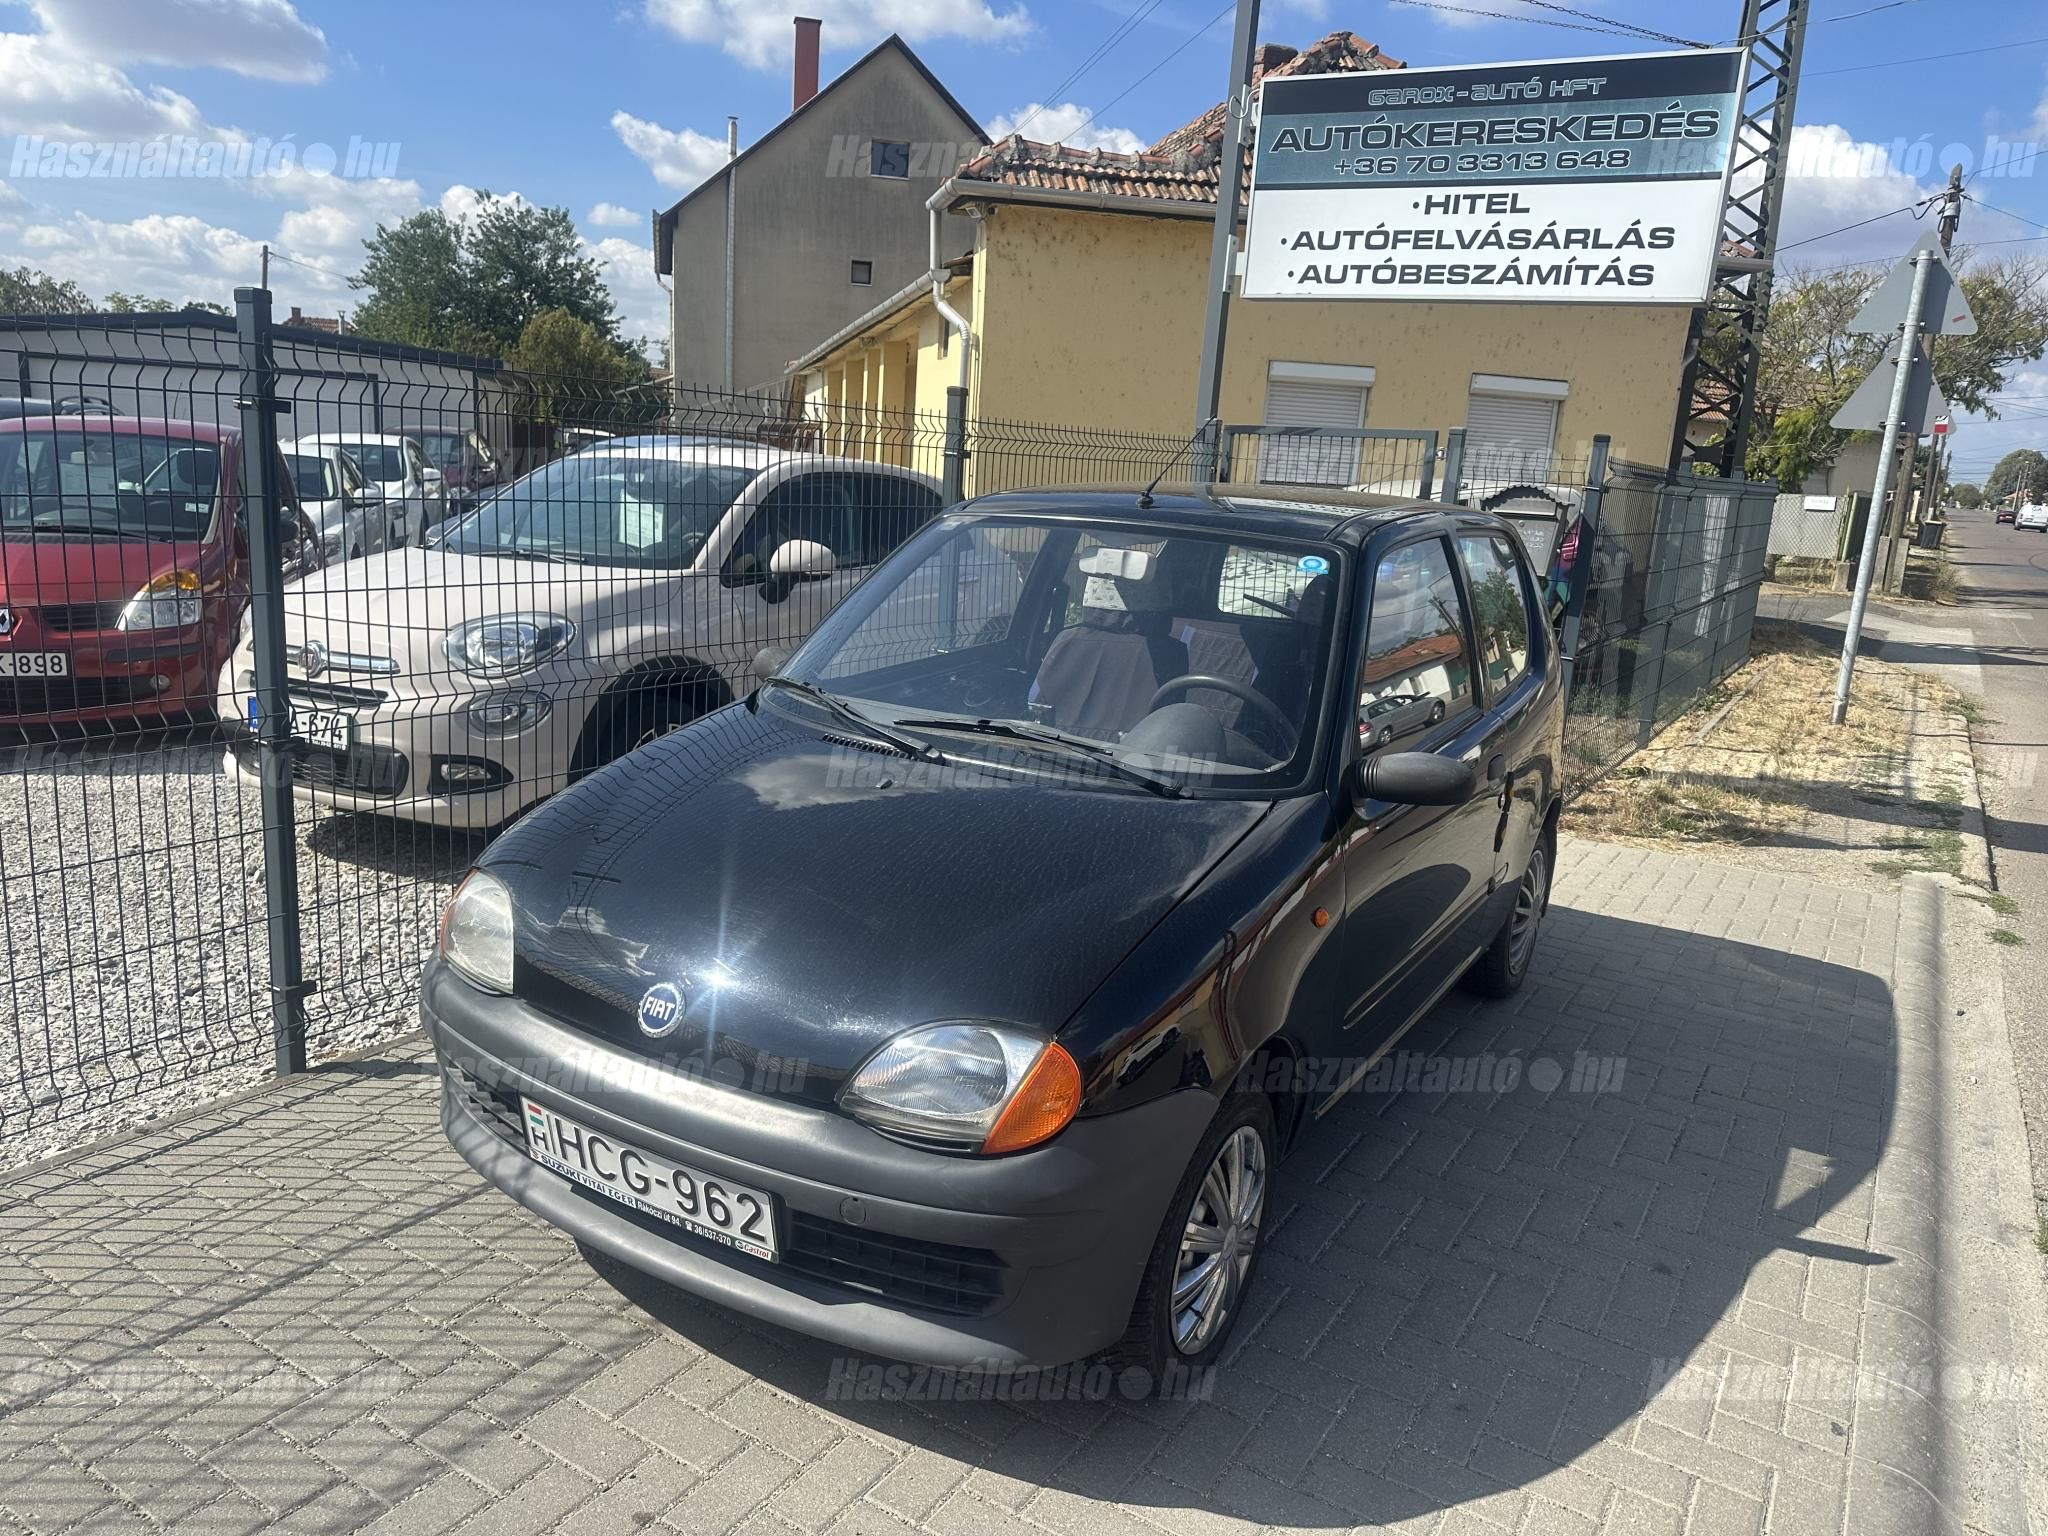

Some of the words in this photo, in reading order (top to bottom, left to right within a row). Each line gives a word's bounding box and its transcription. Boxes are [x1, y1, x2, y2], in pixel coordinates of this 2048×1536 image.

[1269, 99, 1721, 154] AUTÓKERESKEDÉS
[1334, 156, 1398, 175] +36
[1405, 154, 1450, 174] 70
[1456, 151, 1548, 173] 3313
[1556, 148, 1631, 169] 648
[1424, 193, 1531, 215] HITEL
[1290, 219, 1676, 251] AUTÓFELVÁSÁRLÁS
[1298, 256, 1655, 286] AUTÓBESZÁMÍTÁS
[643, 996, 675, 1021] FIAT
[531, 1126, 549, 1151] H
[555, 1117, 767, 1242] HCG-962
[541, 1153, 581, 1181] SUZUKI
[608, 1188, 635, 1206] EGER
[744, 1243, 770, 1259] Castrol
